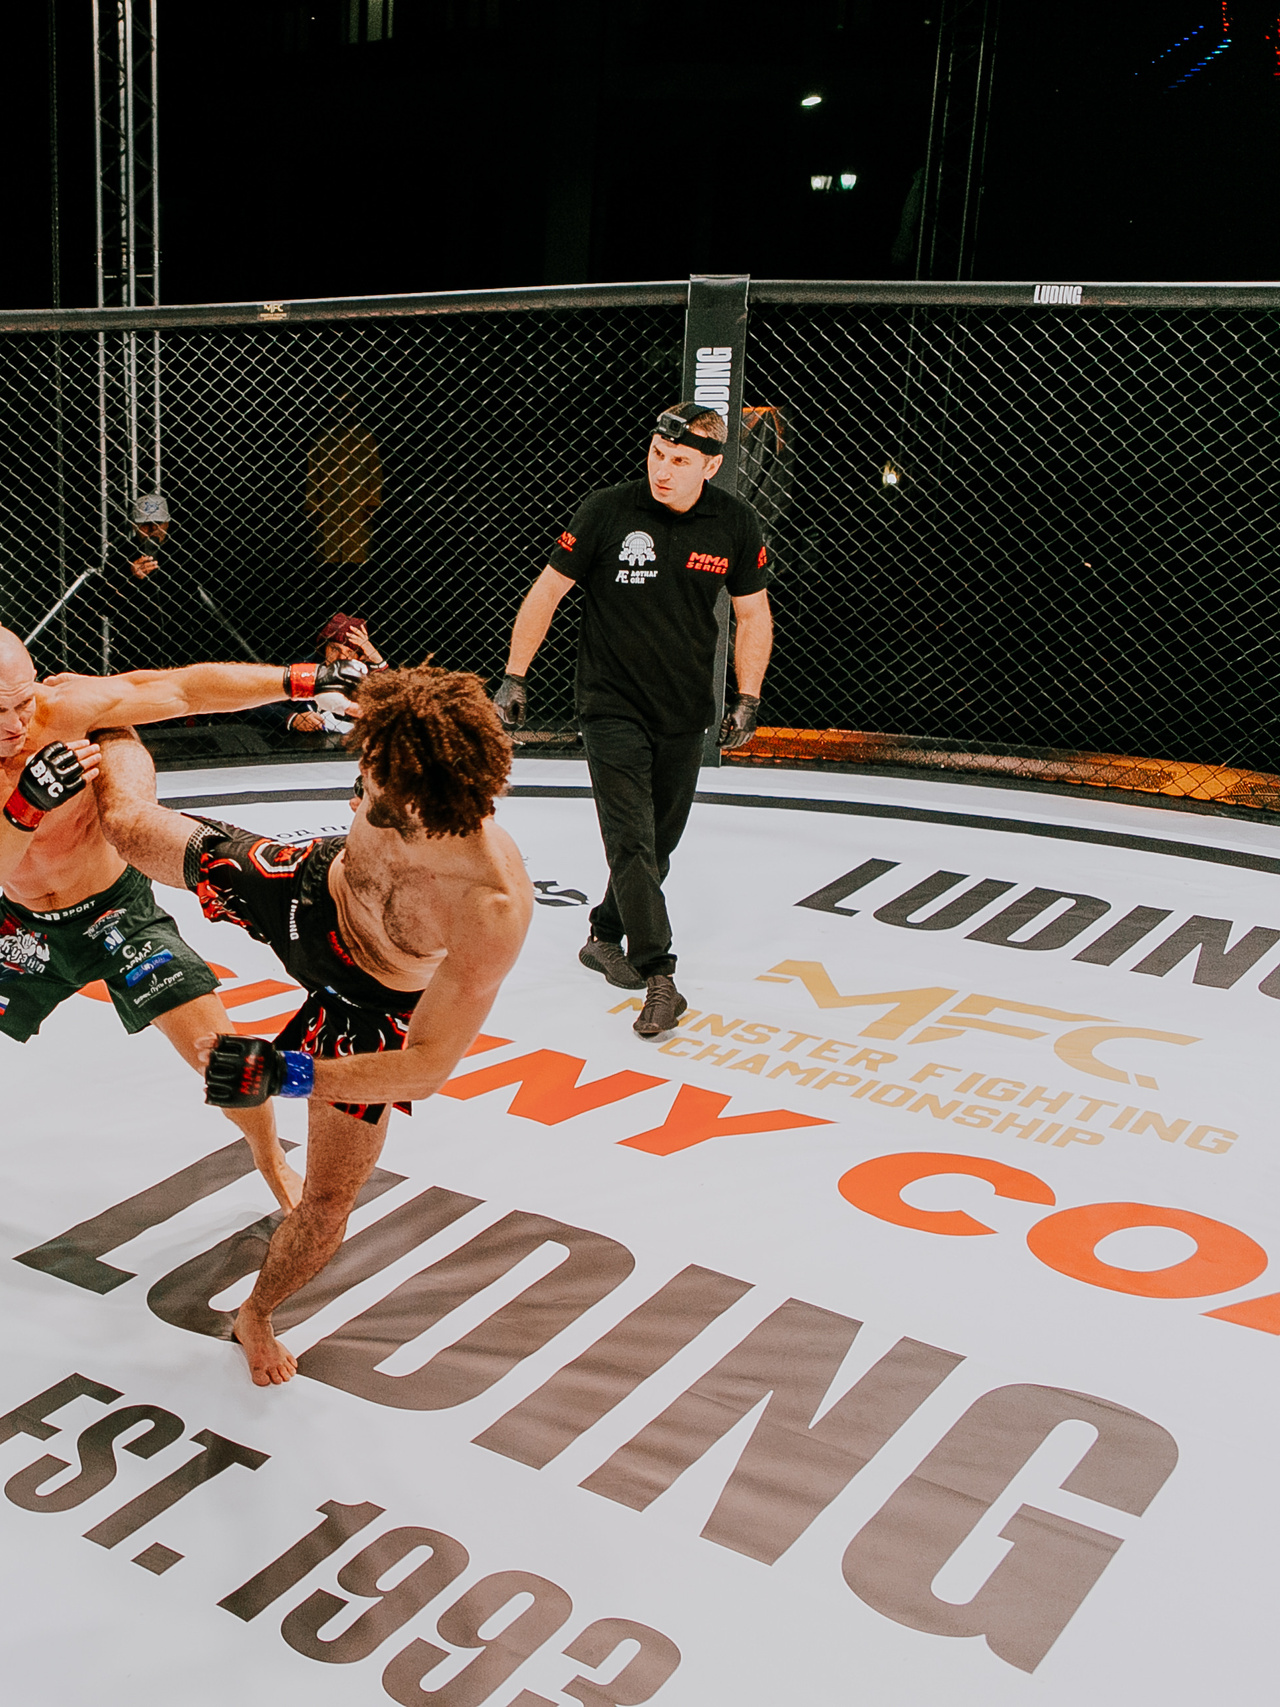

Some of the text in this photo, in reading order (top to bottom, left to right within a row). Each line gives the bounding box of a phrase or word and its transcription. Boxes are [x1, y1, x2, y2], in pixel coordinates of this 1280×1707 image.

[1033, 284, 1083, 305] LUDING
[694, 346, 732, 427] UDING
[686, 562, 728, 575] SERIES
[690, 551, 729, 568] MMA
[30, 759, 64, 798] BFC
[62, 900, 96, 917] SPORT
[754, 958, 1204, 1091] MFC
[658, 1036, 1106, 1150] CHAMPIONSHIP
[909, 1063, 1240, 1155] FIGHTING
[13, 1138, 1180, 1674] LUDING
[216, 1499, 682, 1707] 1993
